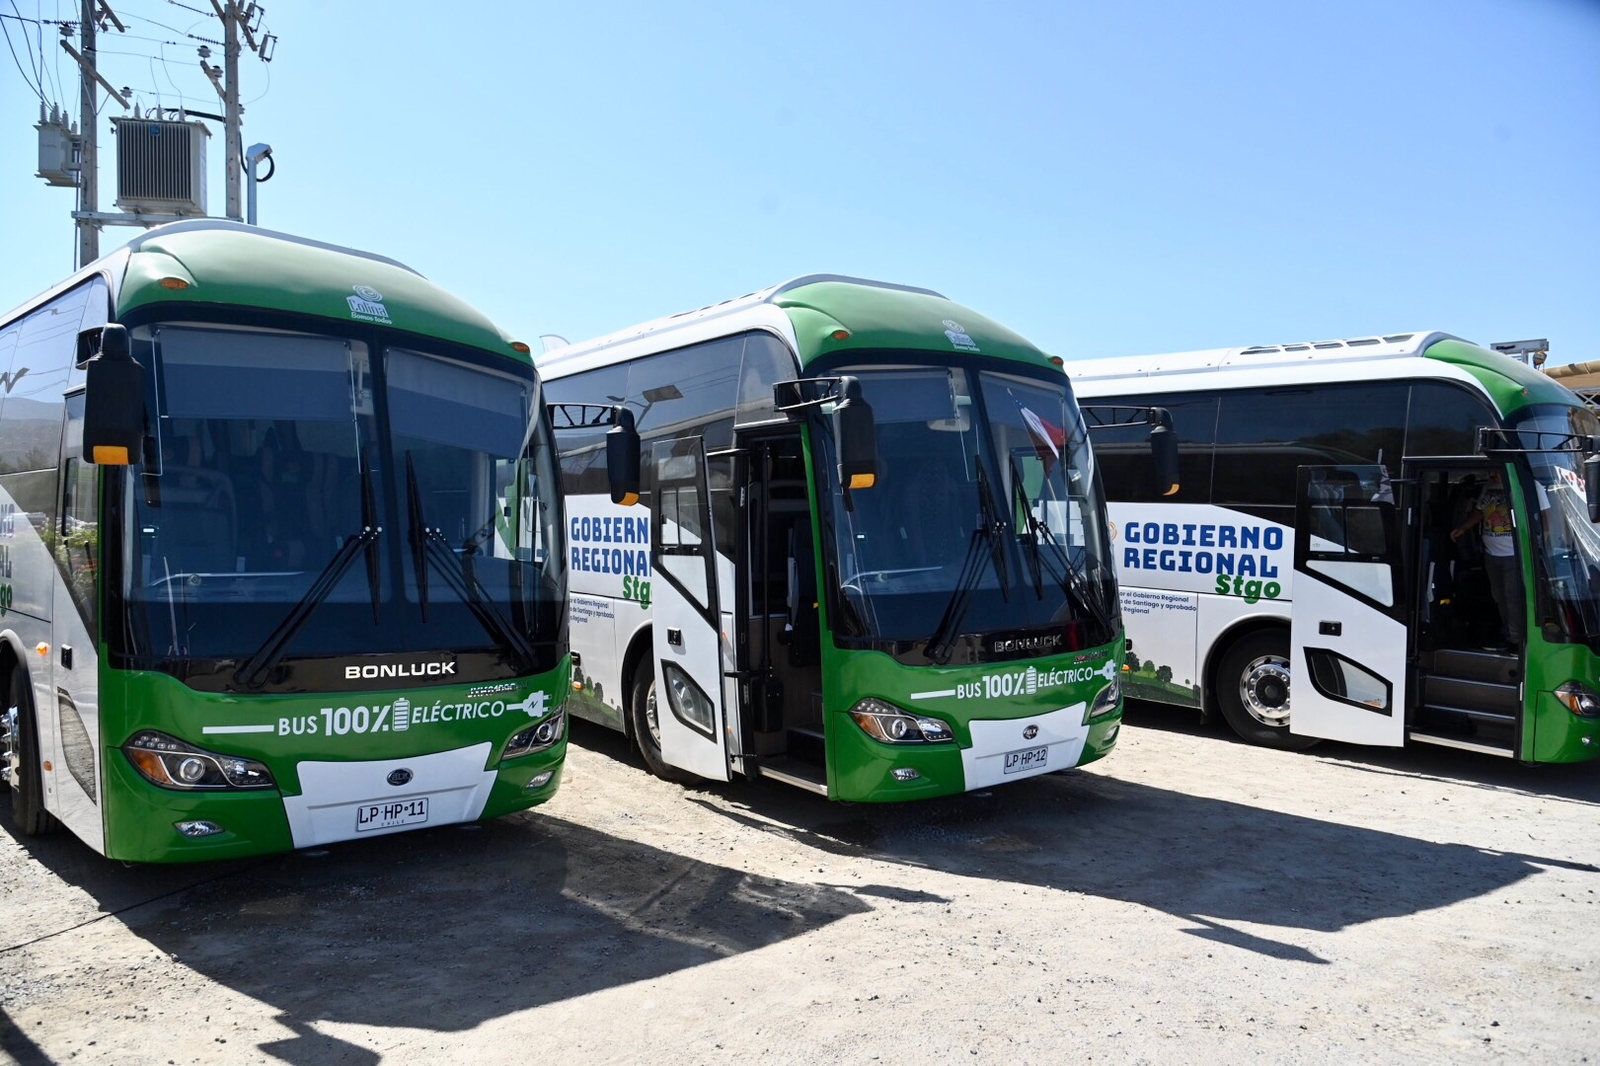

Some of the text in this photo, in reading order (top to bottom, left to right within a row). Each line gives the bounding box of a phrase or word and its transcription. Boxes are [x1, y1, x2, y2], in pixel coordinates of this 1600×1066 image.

[571, 516, 648, 544] GOBIERN
[1125, 521, 1283, 550] GOBIERNO
[1124, 547, 1278, 578] REGIONAL
[623, 575, 652, 610] Stg
[1133, 592, 1160, 600] Gobierno
[1215, 574, 1281, 604] Stgo
[1132, 600, 1159, 608] Santiago
[994, 634, 1062, 652] BONLUCK
[344, 661, 456, 679] BONLUCK
[957, 666, 1093, 699] BUS 100% ELÉCTRICO
[278, 699, 505, 736] BUS 100% ELÉCTRICO
